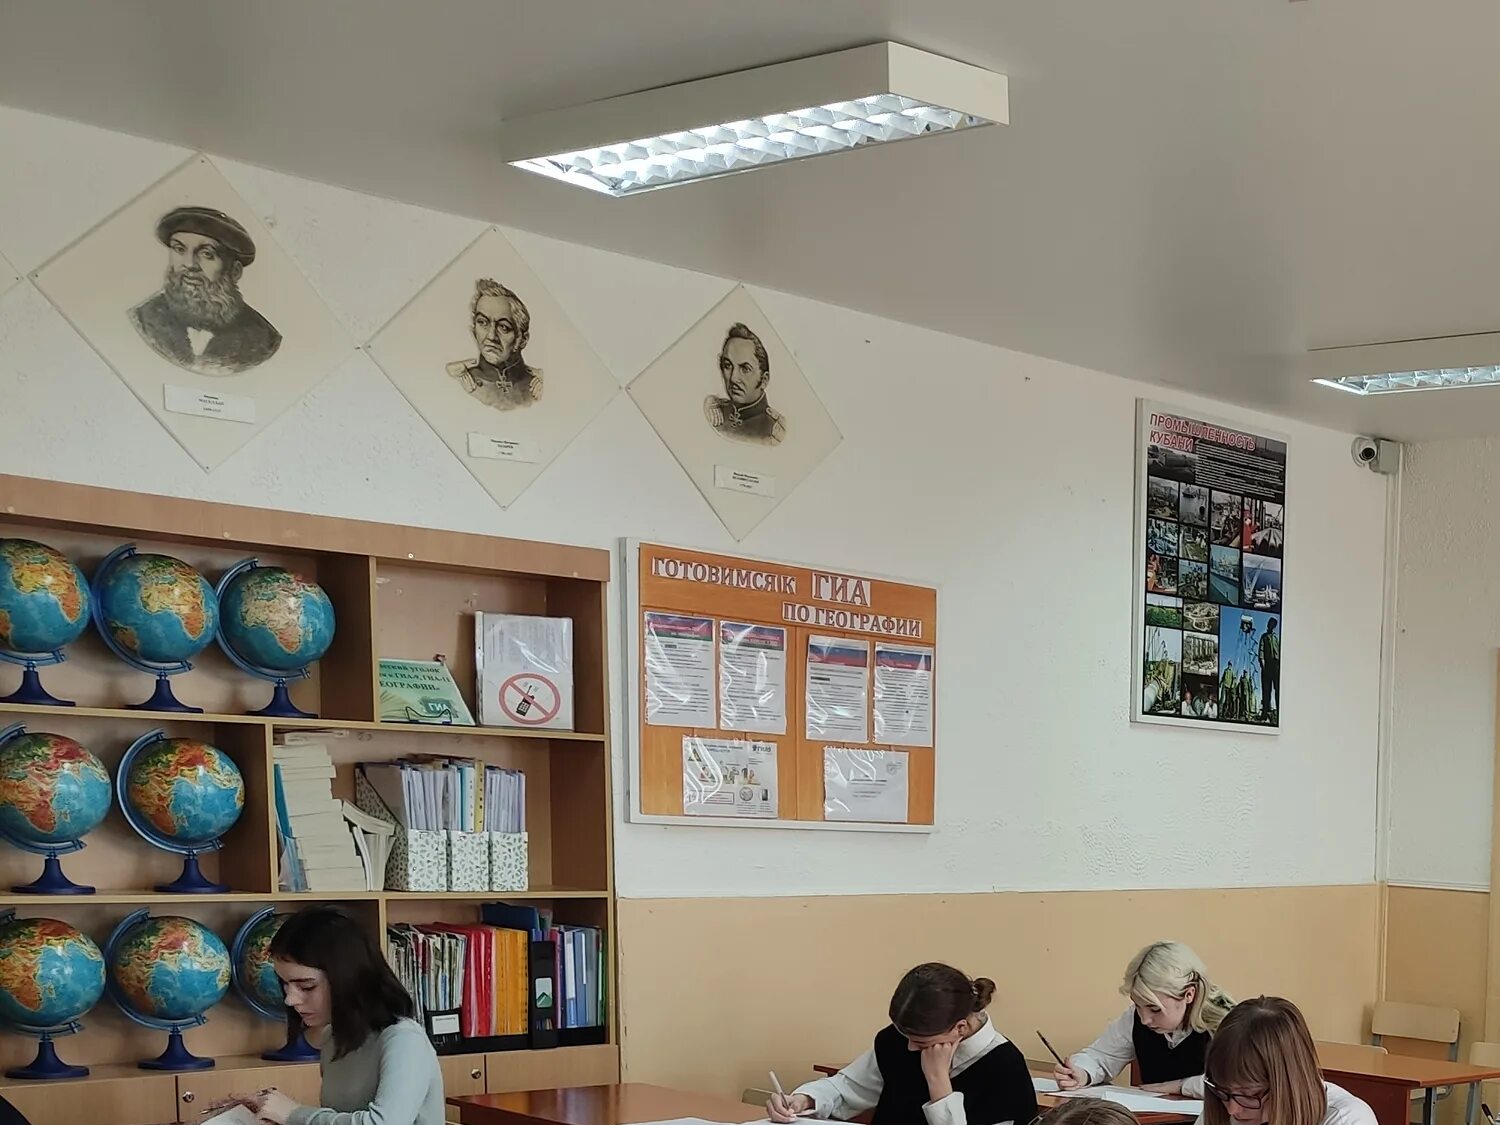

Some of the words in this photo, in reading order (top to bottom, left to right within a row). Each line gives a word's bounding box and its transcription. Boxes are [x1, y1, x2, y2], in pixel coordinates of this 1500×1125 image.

[1150, 413, 1256, 452] ПРОМЫШЛЕННОСТЬ
[1150, 430, 1194, 453] КУБАНИ
[652, 557, 777, 593] ГОТОВИМСЯ
[779, 576, 796, 594] К
[812, 572, 869, 606] ГИА
[784, 602, 810, 622] ПО
[814, 608, 922, 638] ГЕОГРАФИИ
[427, 702, 449, 712] ГИА
